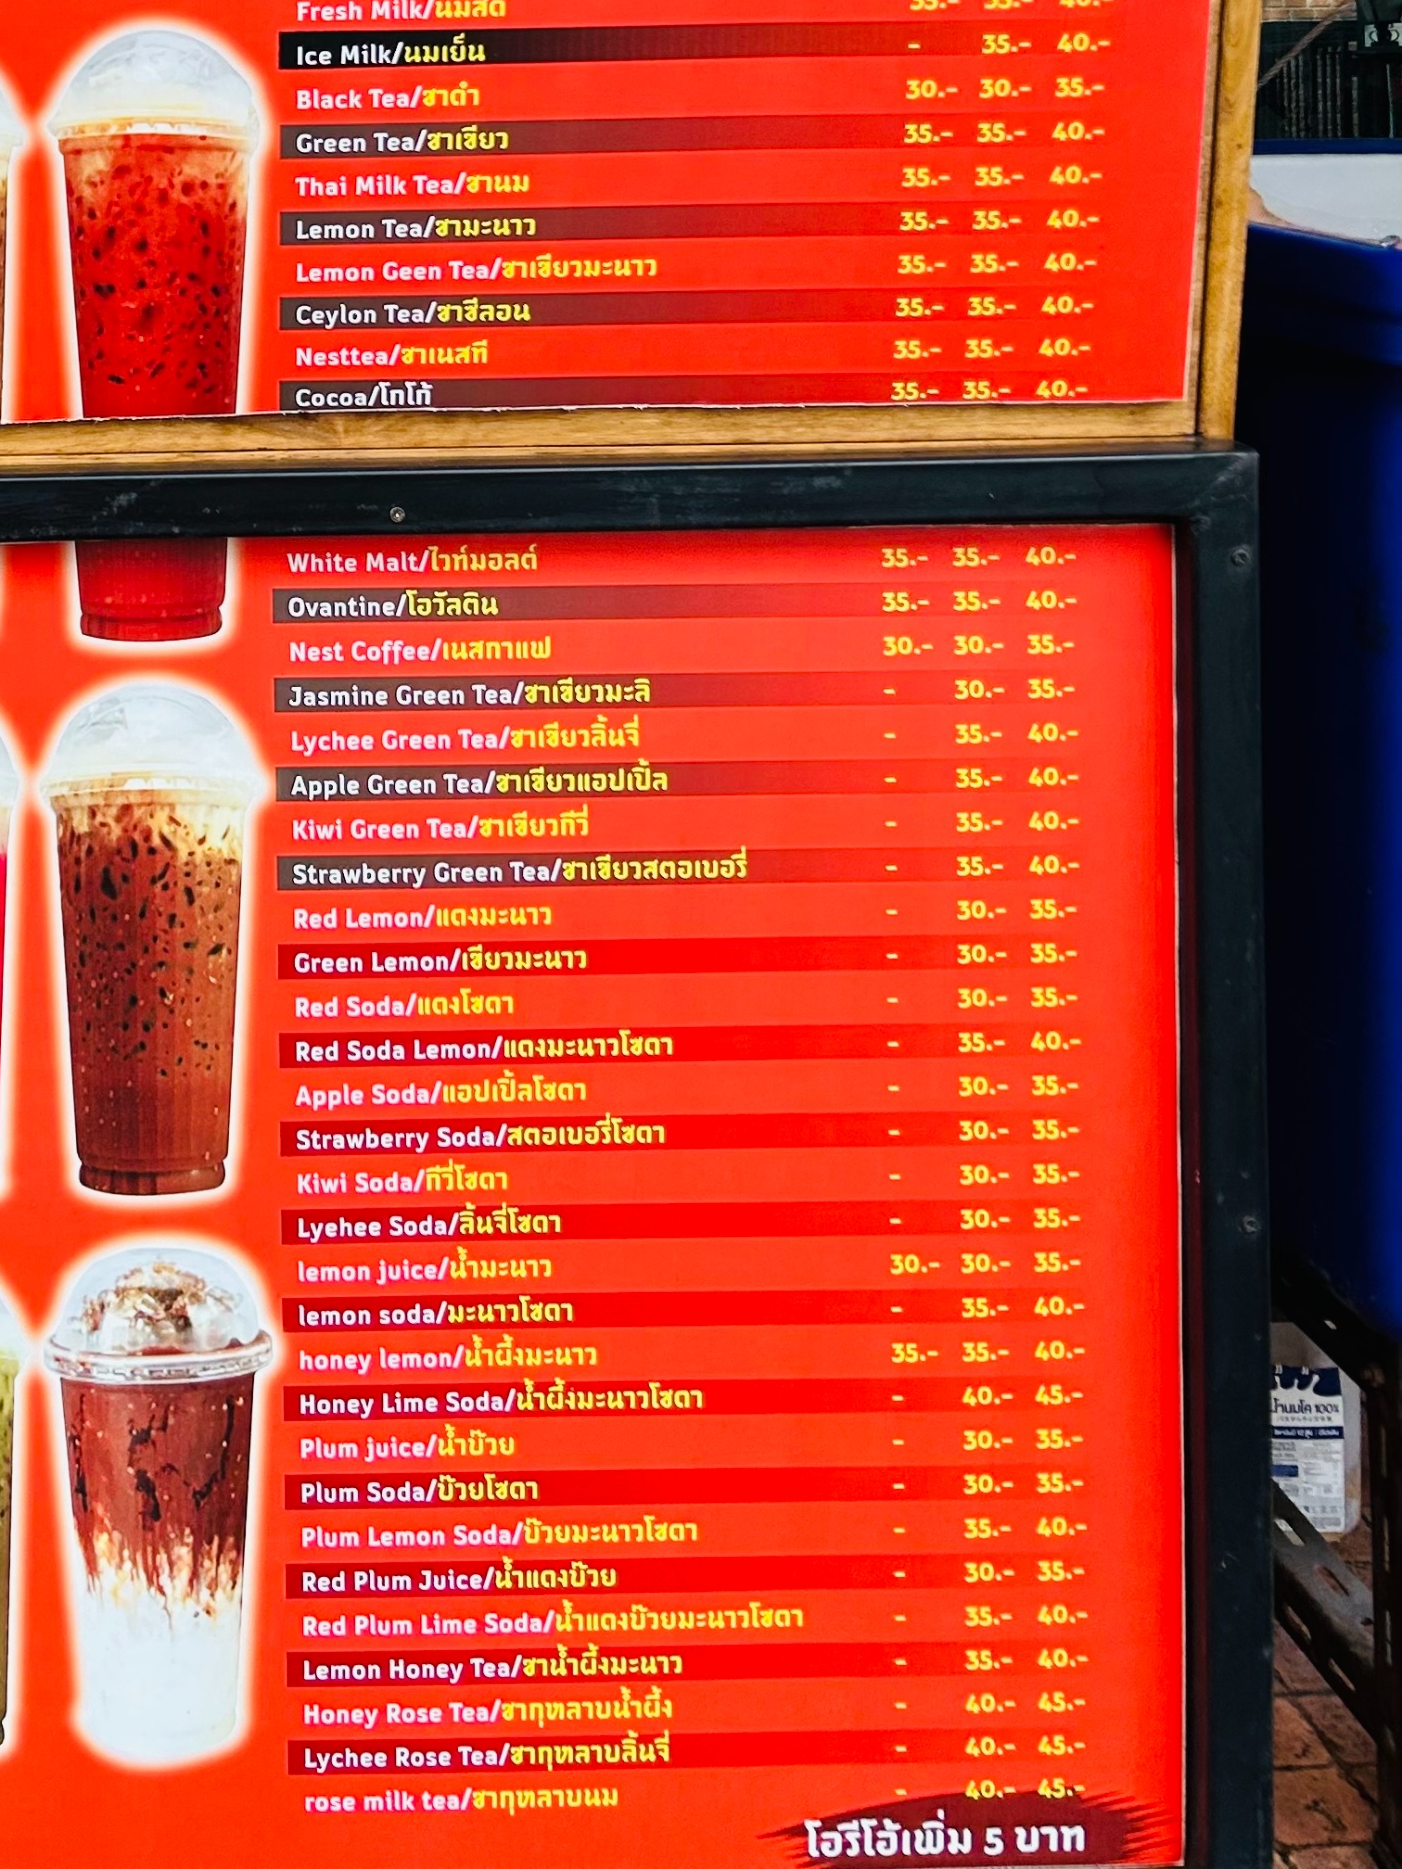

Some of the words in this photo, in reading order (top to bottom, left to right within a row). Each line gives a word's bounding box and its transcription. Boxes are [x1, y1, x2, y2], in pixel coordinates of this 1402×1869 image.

[297, 0, 363, 22] Fresh
[297, 46, 332, 66] Ice
[296, 88, 362, 110] Black
[296, 133, 367, 153] Green
[294, 175, 347, 196] Thai
[355, 174, 407, 196] Milk
[296, 220, 375, 240] Lemon
[296, 263, 374, 282] Lemon
[382, 261, 442, 281] Geen
[296, 303, 377, 330] Ceylon
[287, 552, 357, 573] White
[289, 641, 345, 662] Nest
[292, 862, 427, 889] Strawberry
[434, 861, 503, 883] Green
[295, 1040, 339, 1062] Red
[347, 1039, 405, 1061] Soda
[298, 1260, 371, 1282] lemon
[300, 1437, 358, 1459] Plum
[303, 1615, 346, 1636] Red
[354, 1613, 413, 1636] Plum
[421, 1613, 477, 1635] Lime
[305, 1796, 356, 1812] rose
[363, 1789, 415, 1811] milk
[803, 1808, 973, 1858] โอรีโอ้เพิ่ม
[983, 1827, 1005, 1856] 5
[1014, 1824, 1086, 1854] บาท
